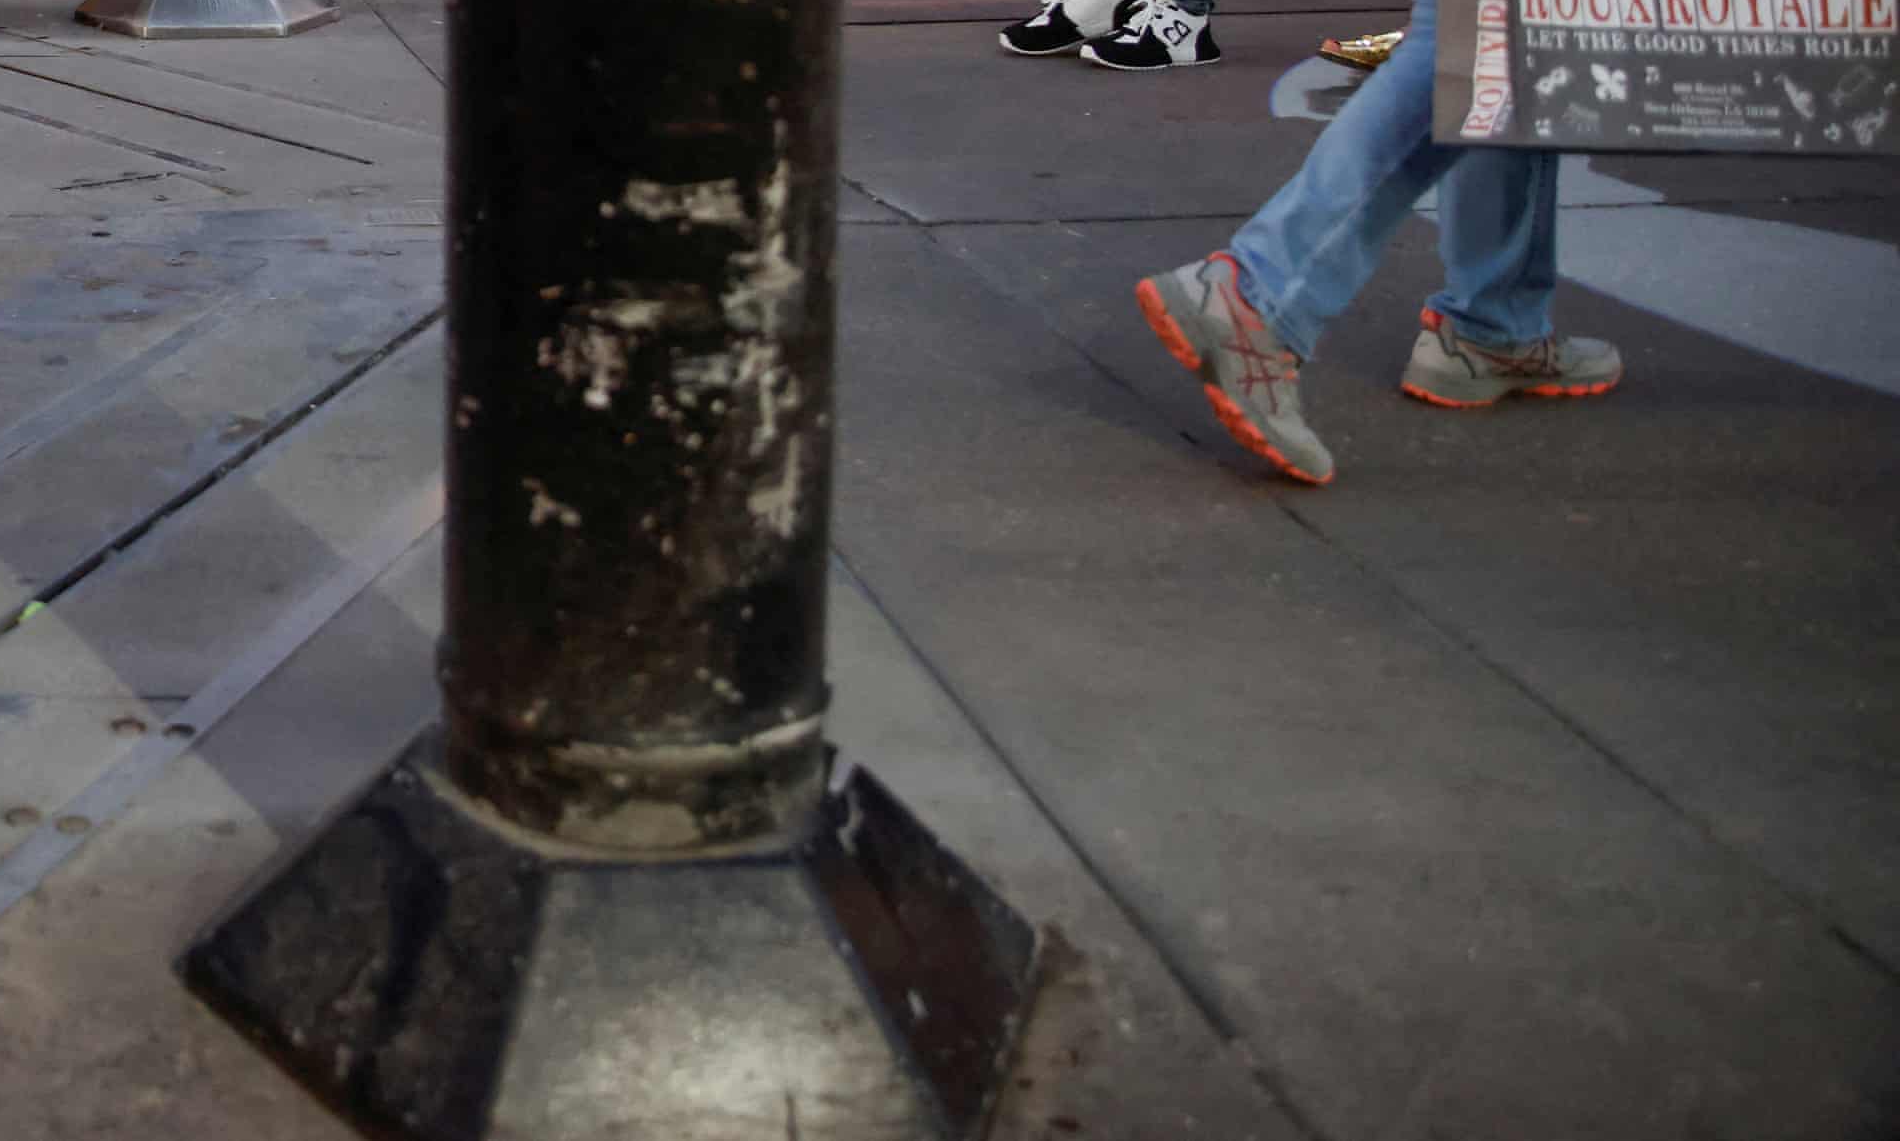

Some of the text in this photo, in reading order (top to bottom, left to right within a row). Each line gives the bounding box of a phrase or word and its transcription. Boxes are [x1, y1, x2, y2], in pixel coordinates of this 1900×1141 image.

[1526, 27, 1890, 58] LET THE GOOD TIMES ROLL!
